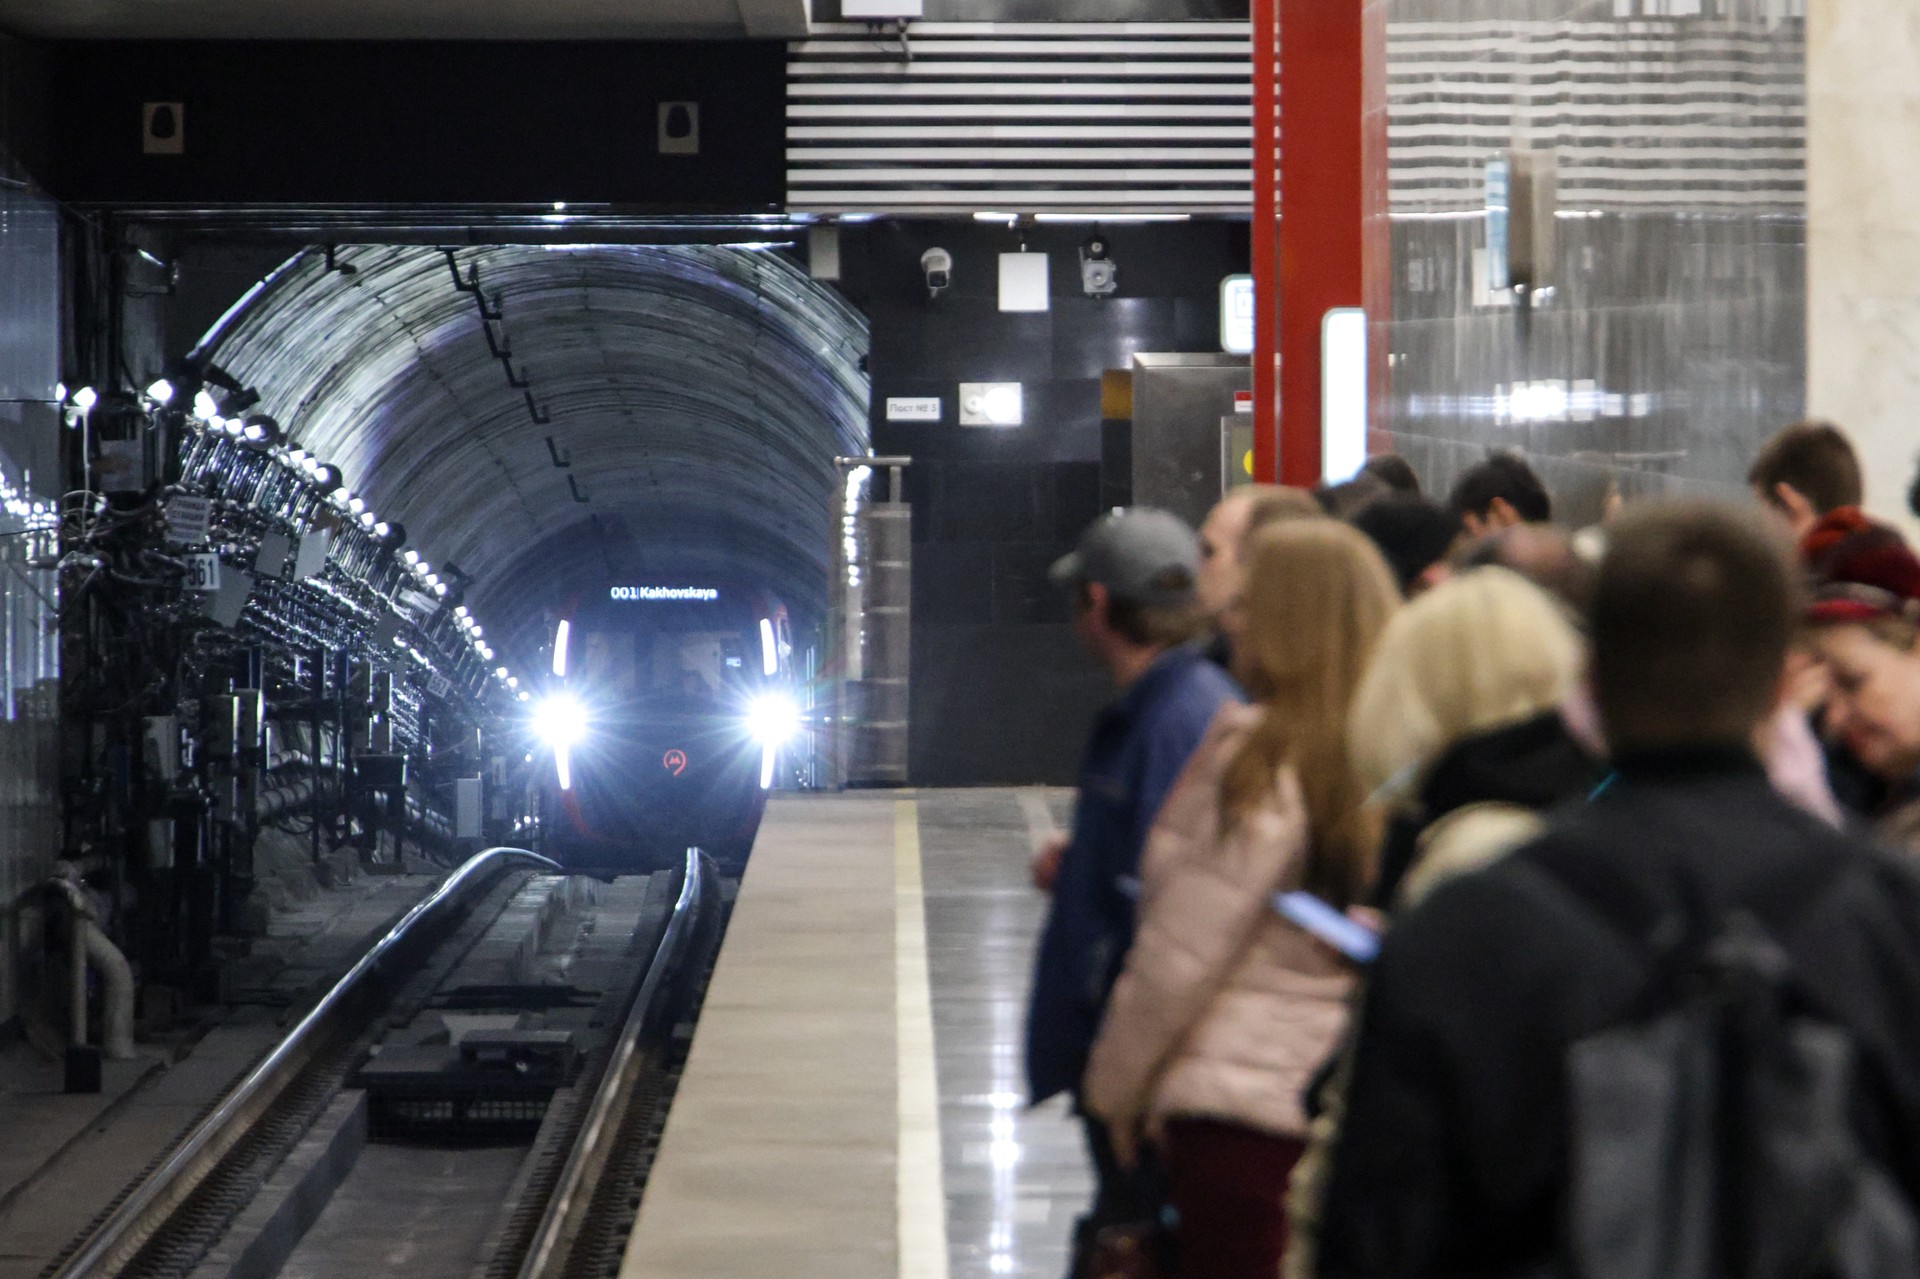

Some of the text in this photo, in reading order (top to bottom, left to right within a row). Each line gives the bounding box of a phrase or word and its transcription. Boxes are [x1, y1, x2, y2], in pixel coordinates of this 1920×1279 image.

[889, 403, 937, 412] Пост № 3
[187, 558, 215, 586] 561
[610, 586, 719, 601] 001 Kakhovskaya
